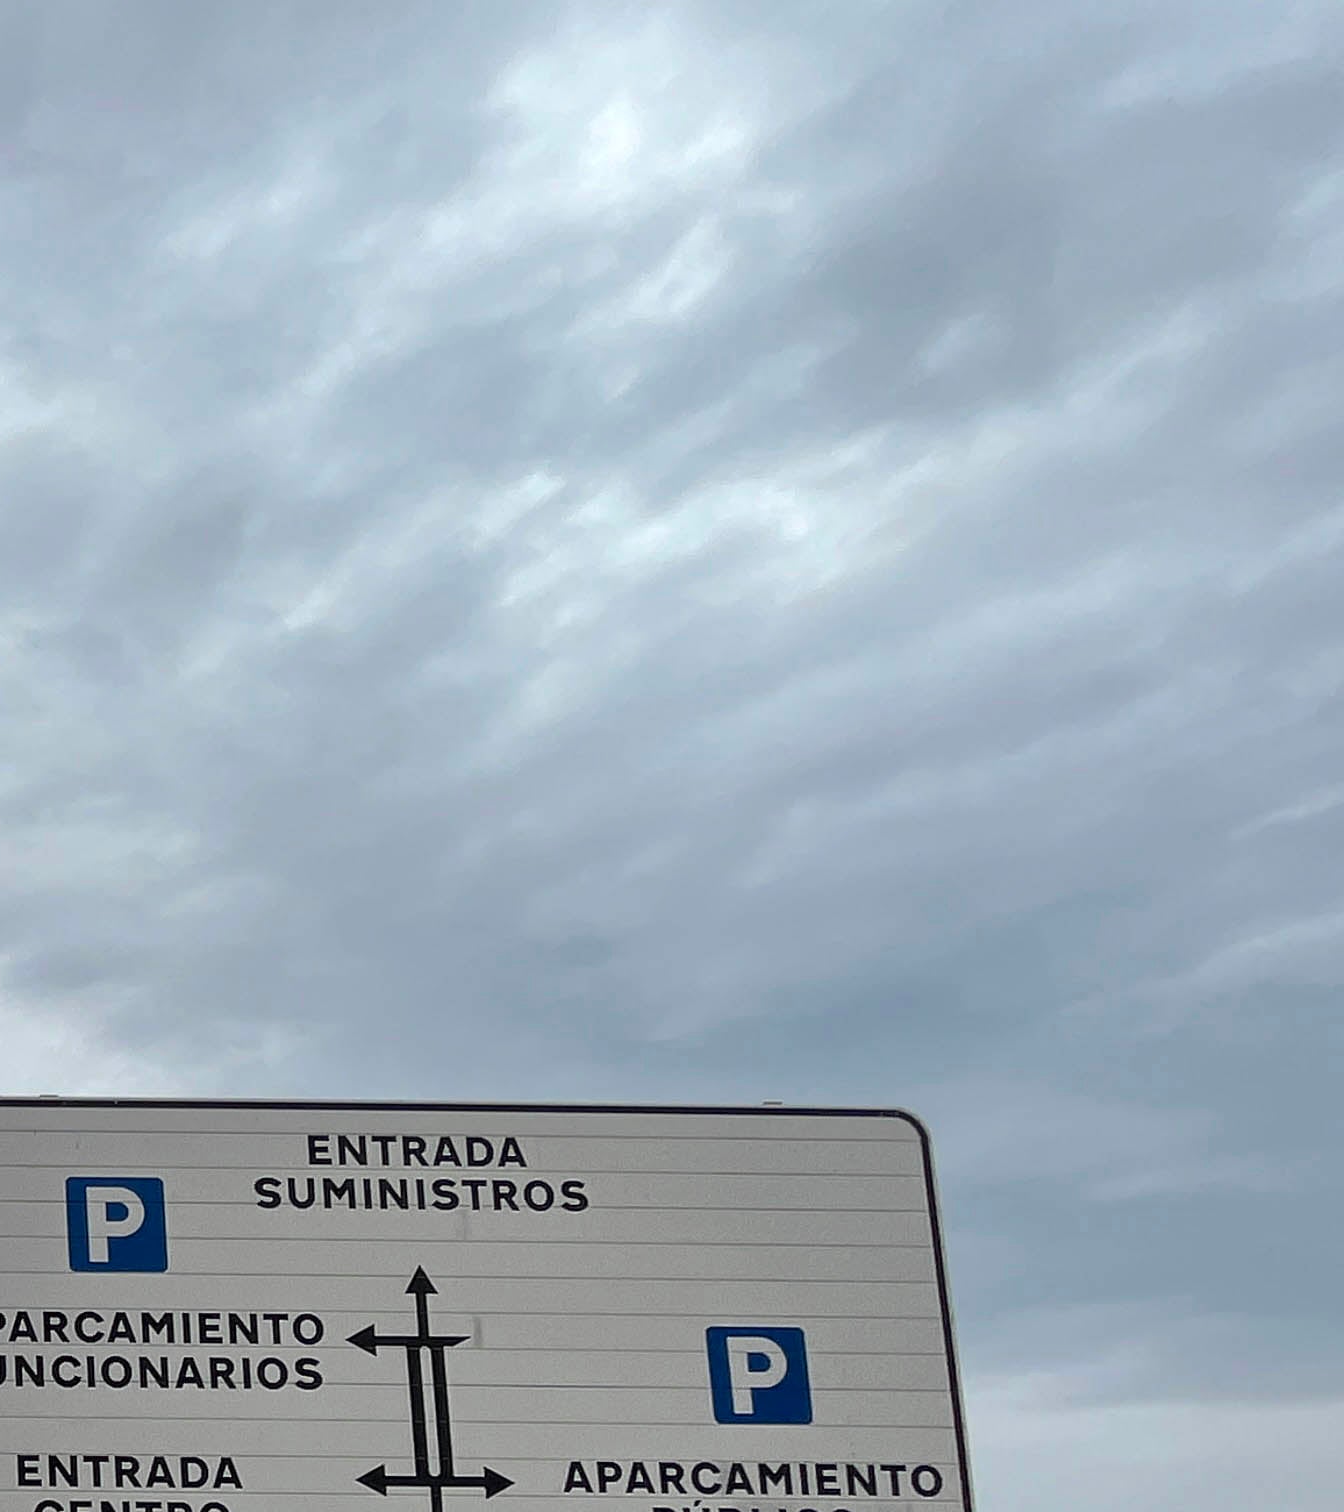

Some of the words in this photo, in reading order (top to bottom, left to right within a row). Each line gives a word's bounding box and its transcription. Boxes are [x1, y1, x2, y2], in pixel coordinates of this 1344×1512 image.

[308, 1135, 528, 1168] ENTRADA
[254, 1177, 589, 1212] SUMINISTROS
[86, 1186, 145, 1263] P
[726, 1336, 787, 1414] P
[16, 1454, 243, 1489] ENTRADA
[563, 1461, 943, 1498] APARCAMIENTO
